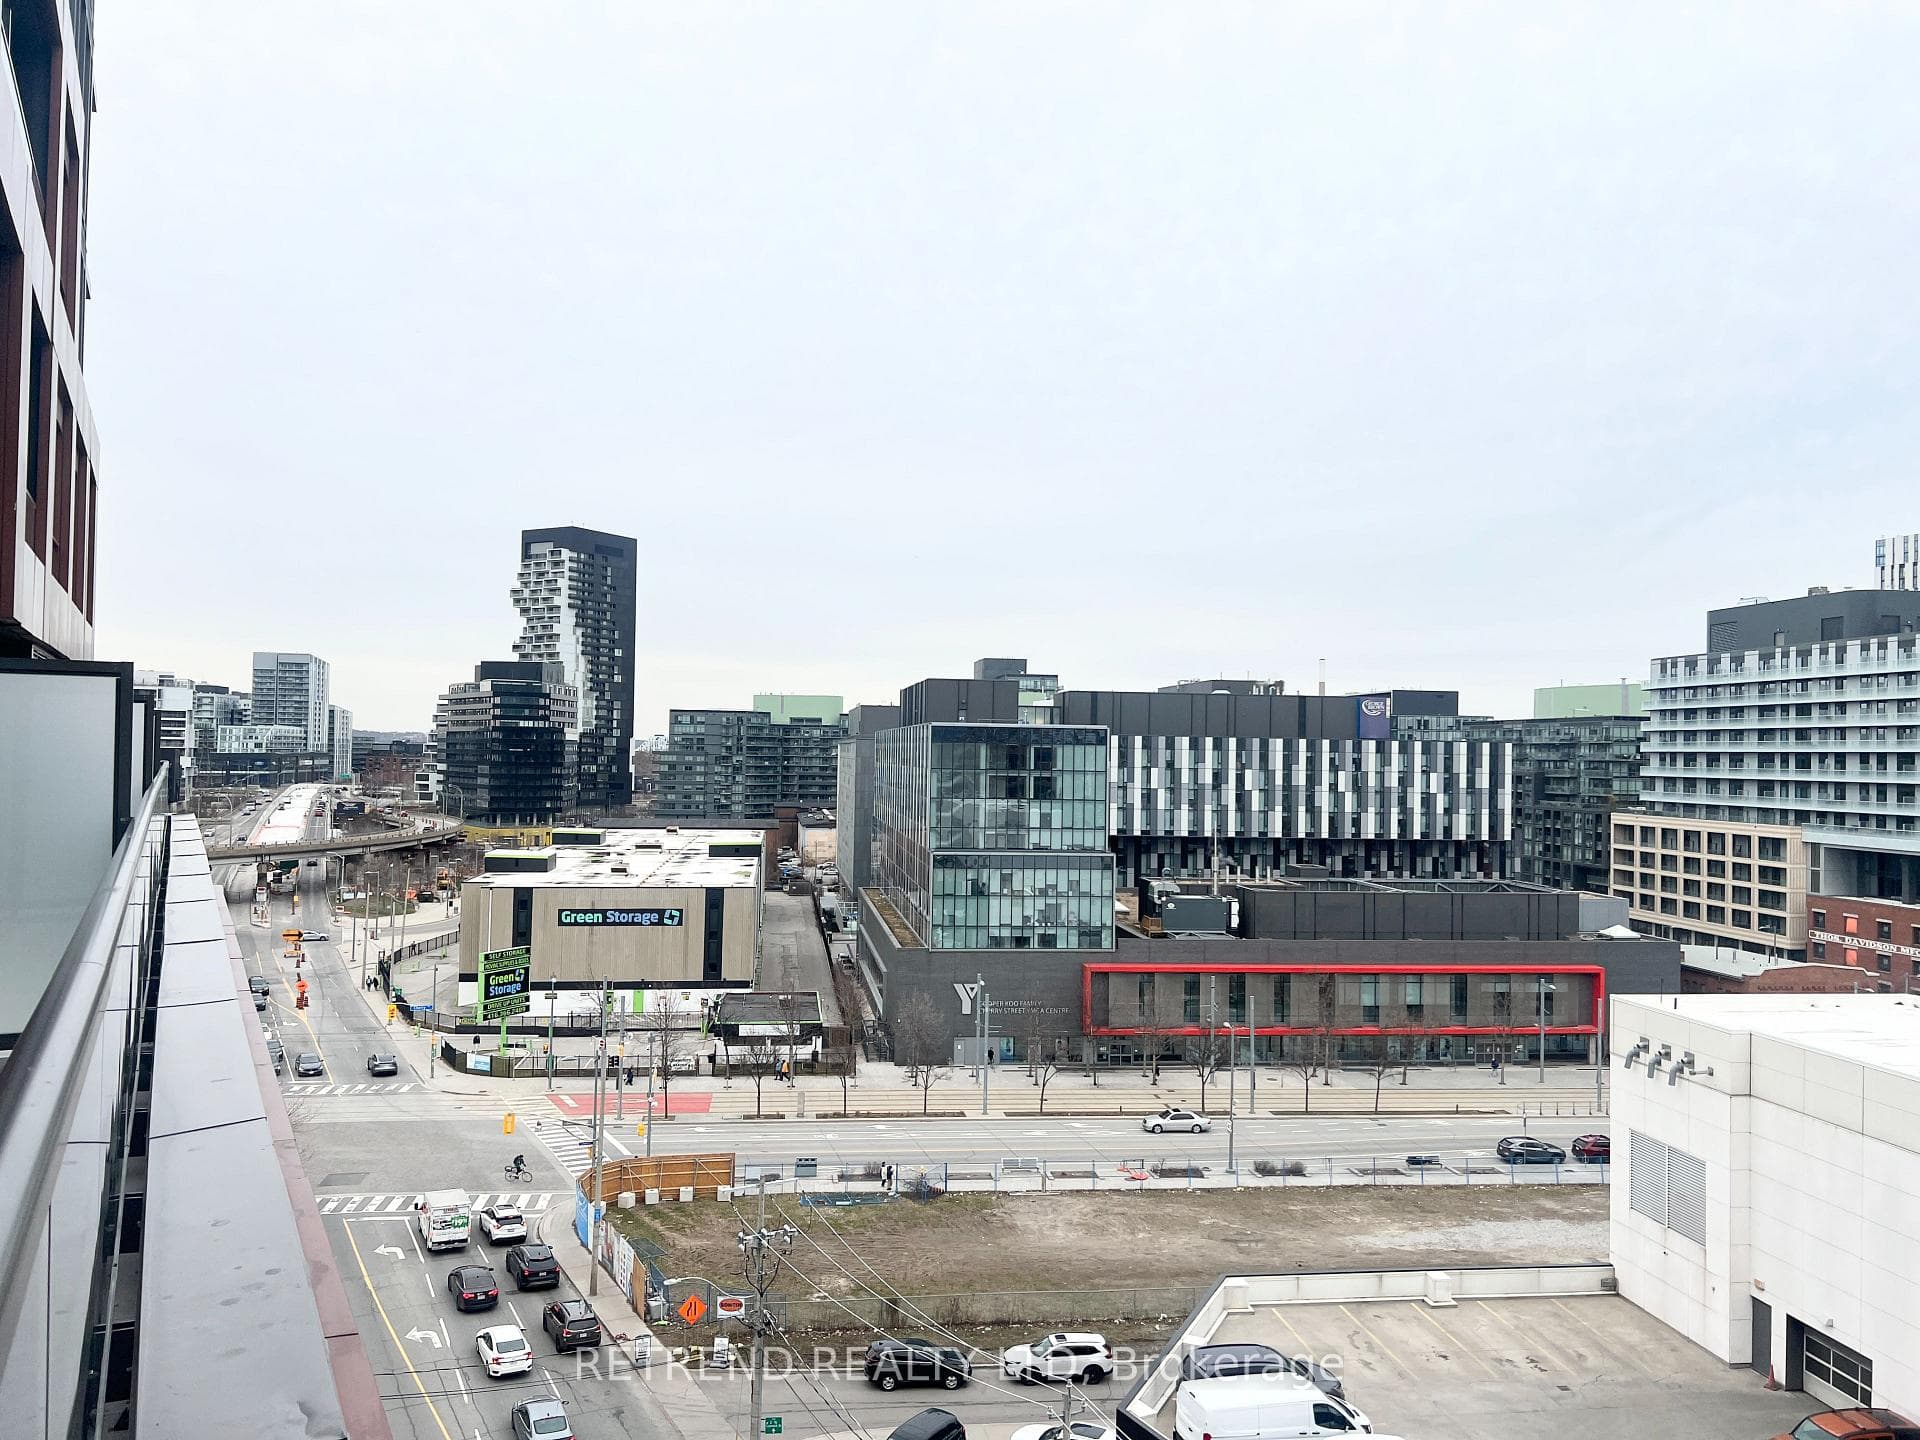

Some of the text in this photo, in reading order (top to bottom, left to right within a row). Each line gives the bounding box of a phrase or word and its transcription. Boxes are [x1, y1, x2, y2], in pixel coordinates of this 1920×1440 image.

[561, 910, 659, 925] Green Storage
[1845, 936, 1897, 952] DAVIDSON
[488, 948, 526, 960] SELF STORAGE
[489, 973, 514, 985] Green
[489, 982, 522, 996] Storage
[980, 1007, 1003, 1015] CRRY
[1003, 1007, 1026, 1015] STREET
[1045, 1007, 1071, 1015] CENTRE
